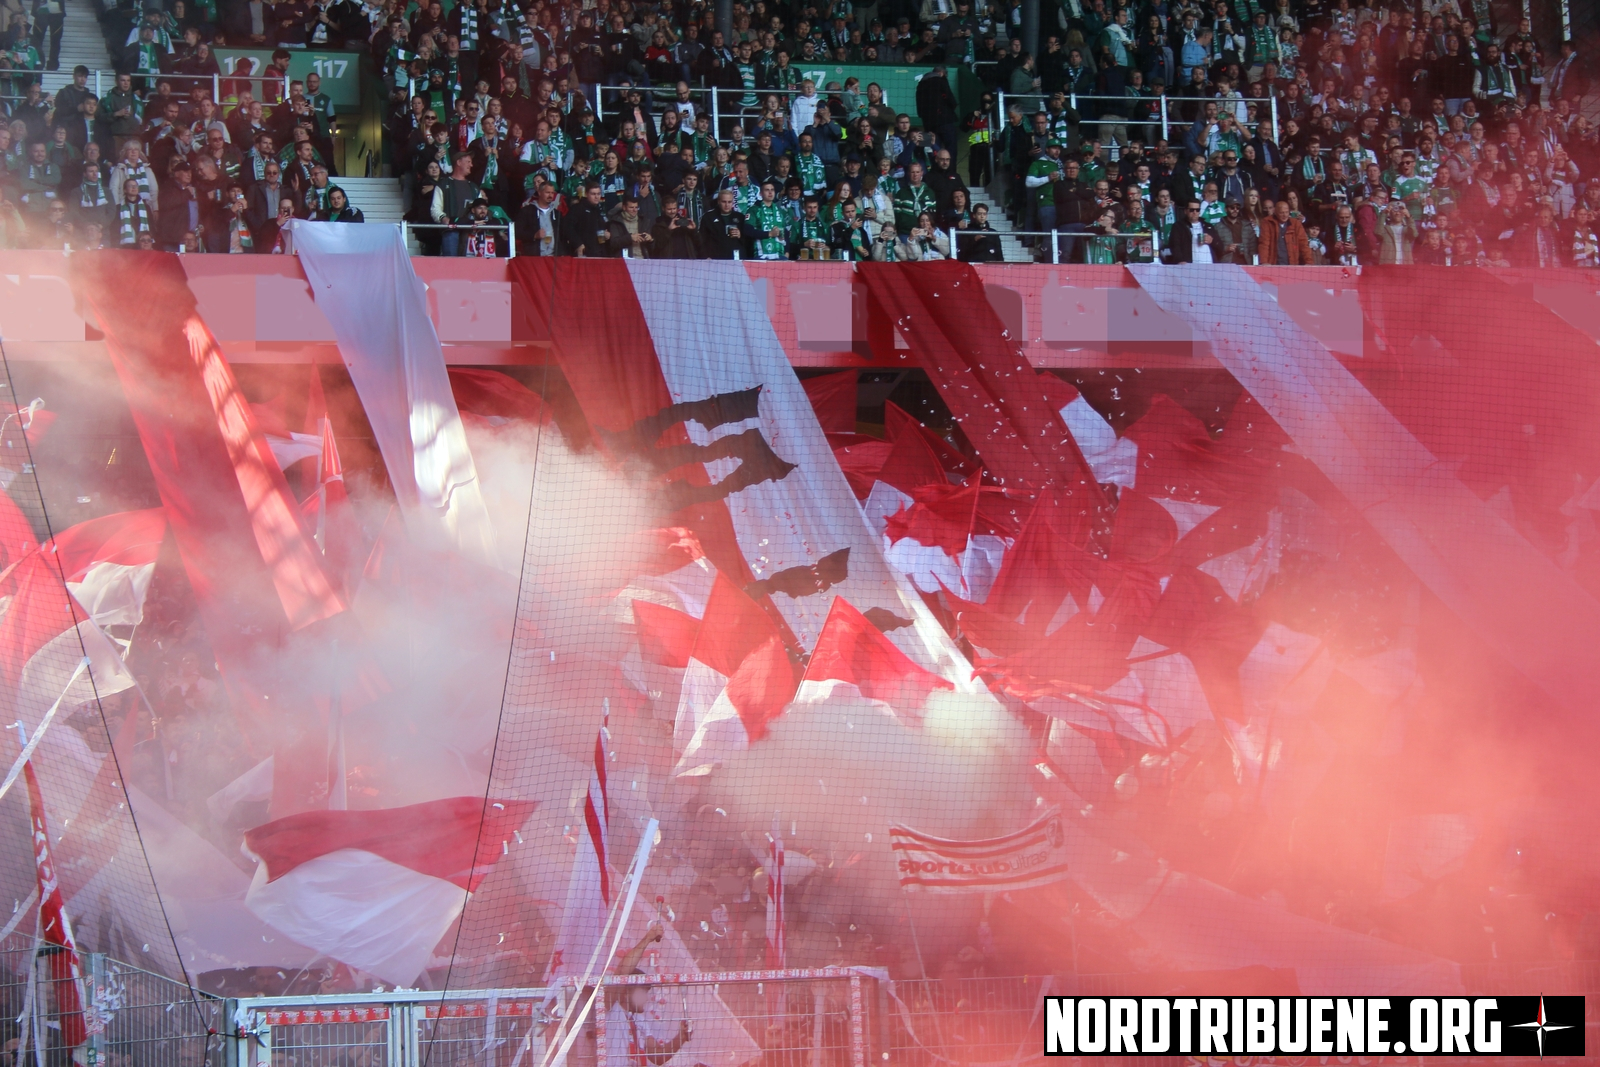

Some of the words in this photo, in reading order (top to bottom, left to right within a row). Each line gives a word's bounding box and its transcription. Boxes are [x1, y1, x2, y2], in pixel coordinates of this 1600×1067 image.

[224, 56, 261, 76] 19
[313, 60, 348, 79] 117
[801, 70, 826, 89] 17
